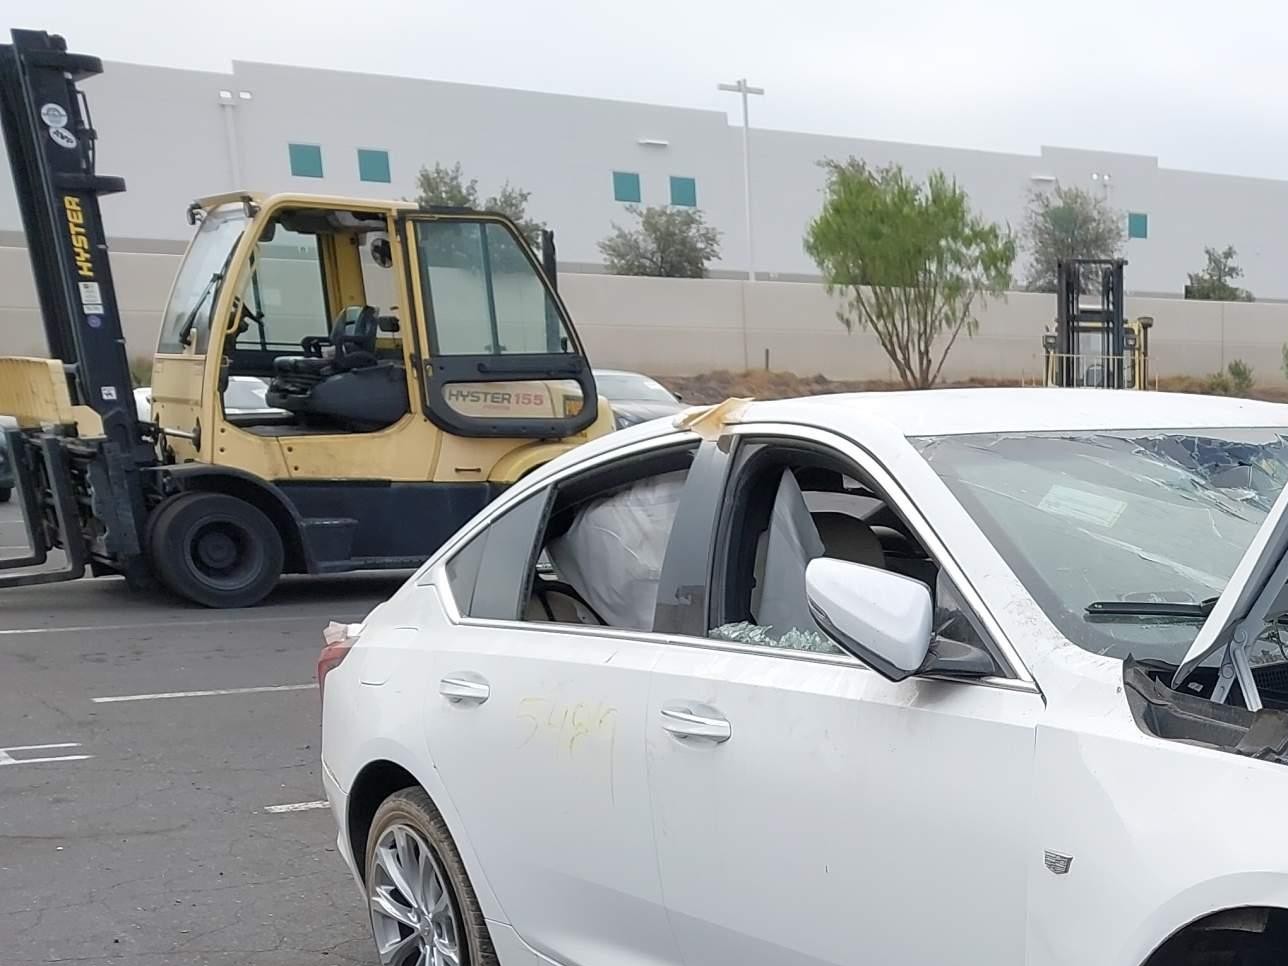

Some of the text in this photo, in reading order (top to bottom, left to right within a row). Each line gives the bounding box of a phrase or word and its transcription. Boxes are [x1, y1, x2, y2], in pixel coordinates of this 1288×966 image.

[64, 195, 95, 278] HYSTER
[447, 389, 544, 407] HYSTER 155
